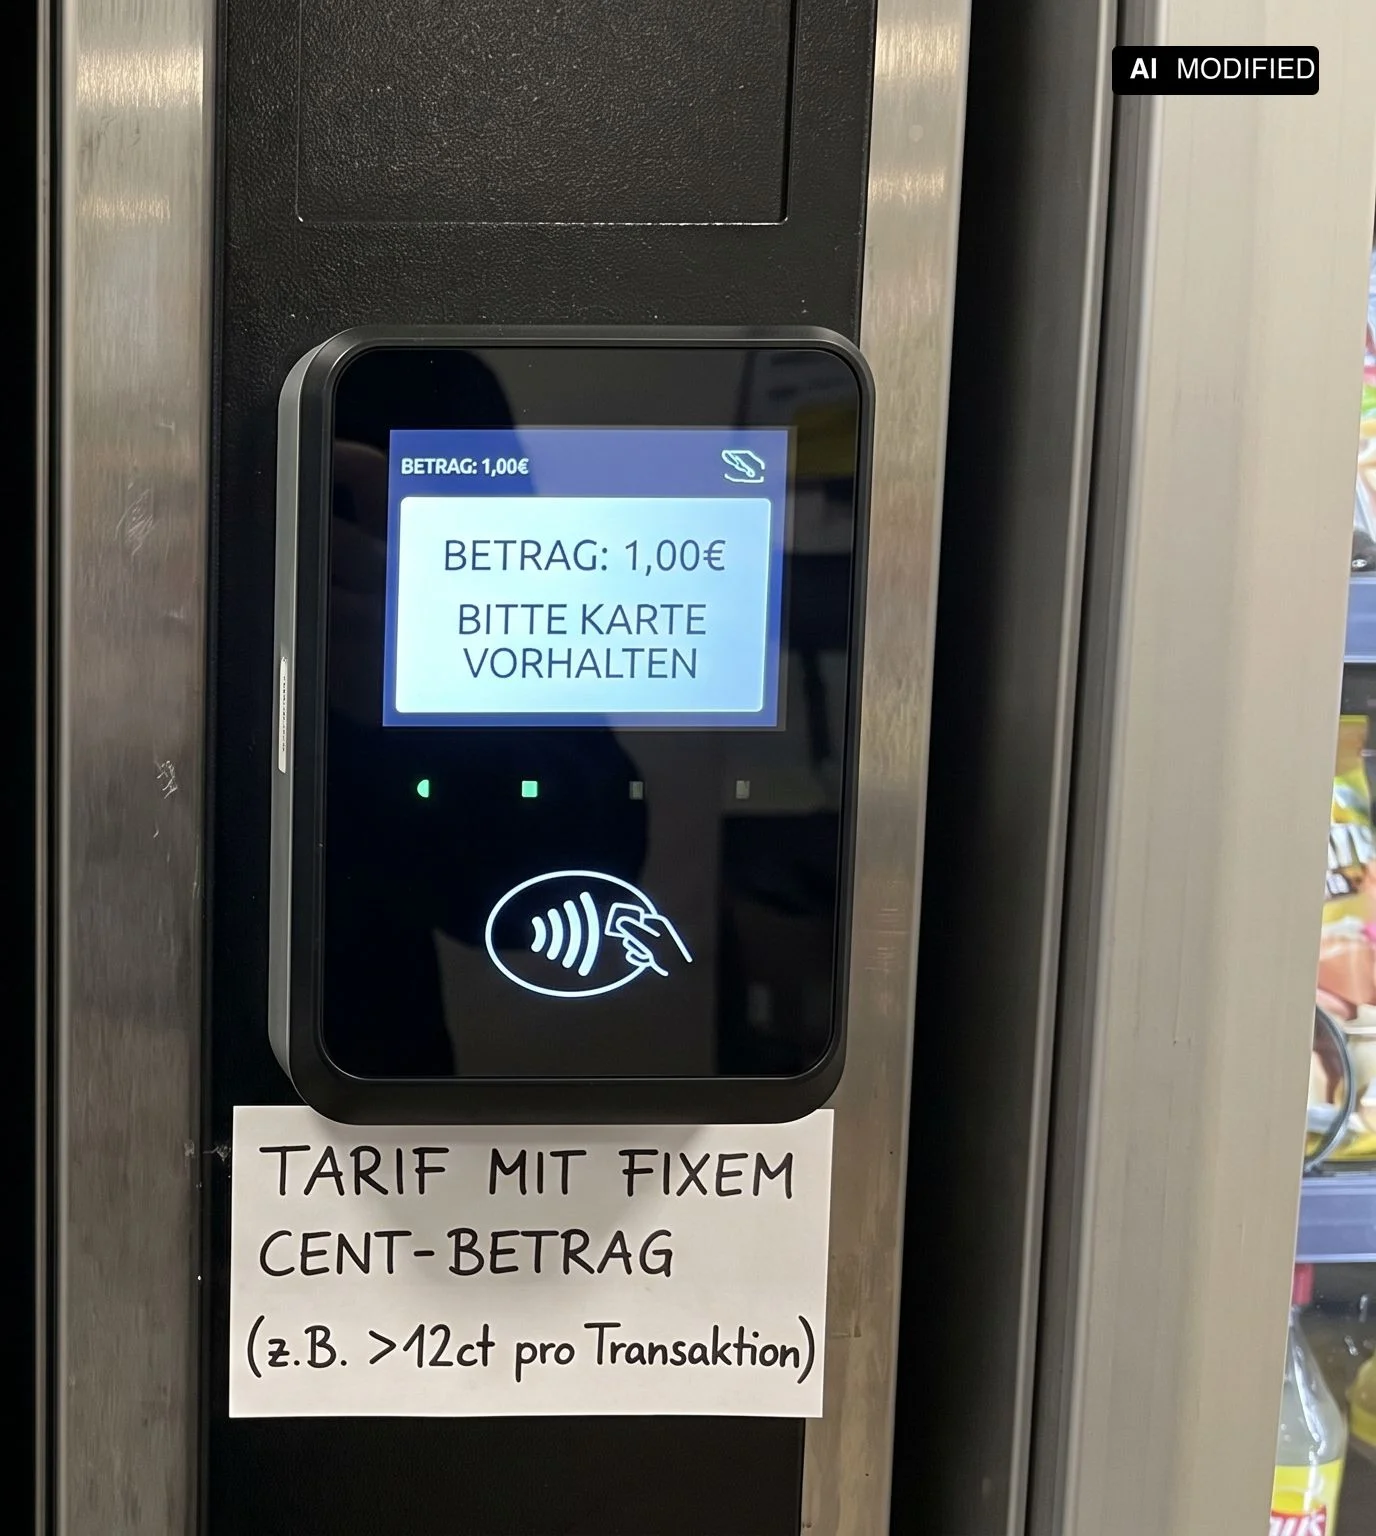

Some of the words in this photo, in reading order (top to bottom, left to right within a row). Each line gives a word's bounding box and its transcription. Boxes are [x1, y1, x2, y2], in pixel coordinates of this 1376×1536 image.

[400, 457, 478, 476] BETRAG:
[481, 457, 530, 477] 1,00€
[444, 539, 609, 572] BETRAG:
[624, 538, 727, 577] 1,00€
[458, 603, 567, 636] BITTE
[581, 603, 707, 636] KARTE
[463, 647, 697, 679] VORHALTEN
[259, 1144, 450, 1197] TARIF
[488, 1147, 588, 1197] MIT
[618, 1148, 794, 1200] FIXEM
[259, 1227, 674, 1278] CENT-BETRAG
[246, 1315, 348, 1379] (z.B.
[368, 1322, 496, 1369] >12ct
[514, 1342, 576, 1383] pro
[583, 1315, 817, 1385] Transaktion)
